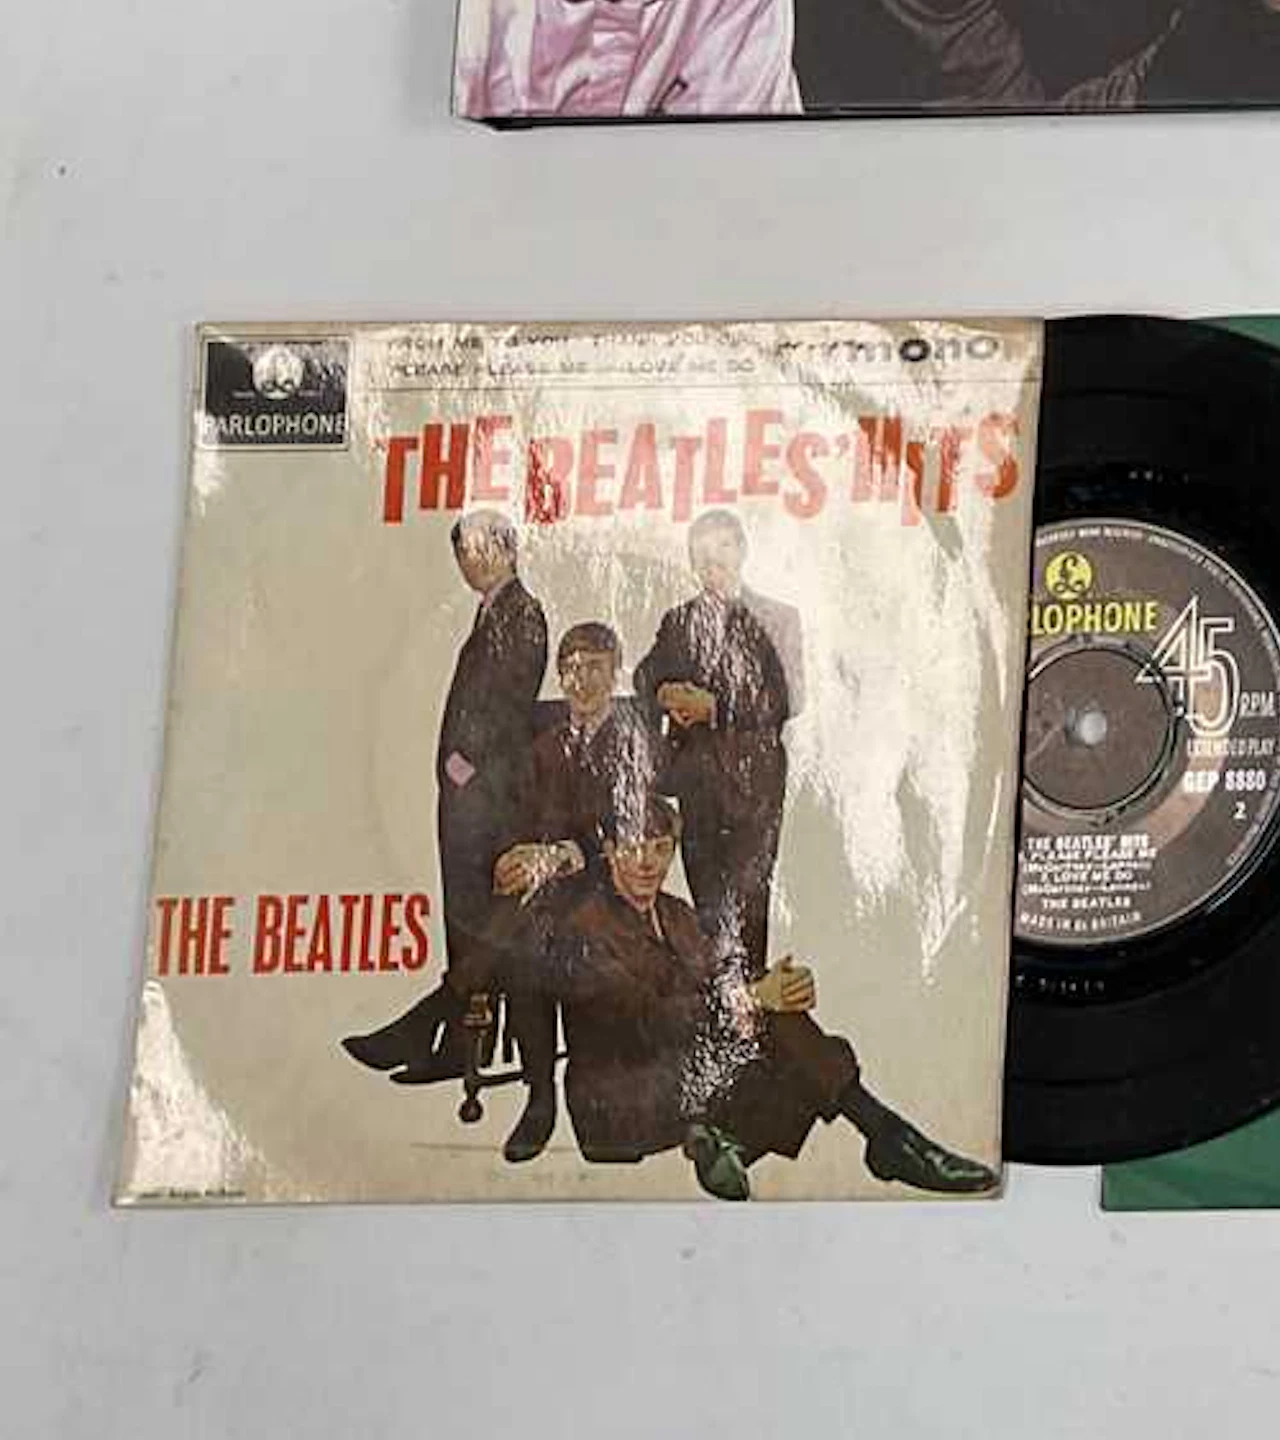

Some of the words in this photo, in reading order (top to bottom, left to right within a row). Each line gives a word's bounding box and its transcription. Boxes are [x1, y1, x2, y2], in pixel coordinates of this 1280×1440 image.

[204, 412, 346, 436] PARLOPHONE
[383, 415, 513, 524] THE
[1135, 594, 1240, 737] 45
[1240, 691, 1276, 716] RPM
[1233, 801, 1247, 820] 2
[156, 896, 235, 976] THE
[253, 892, 431, 974] BEATLES
